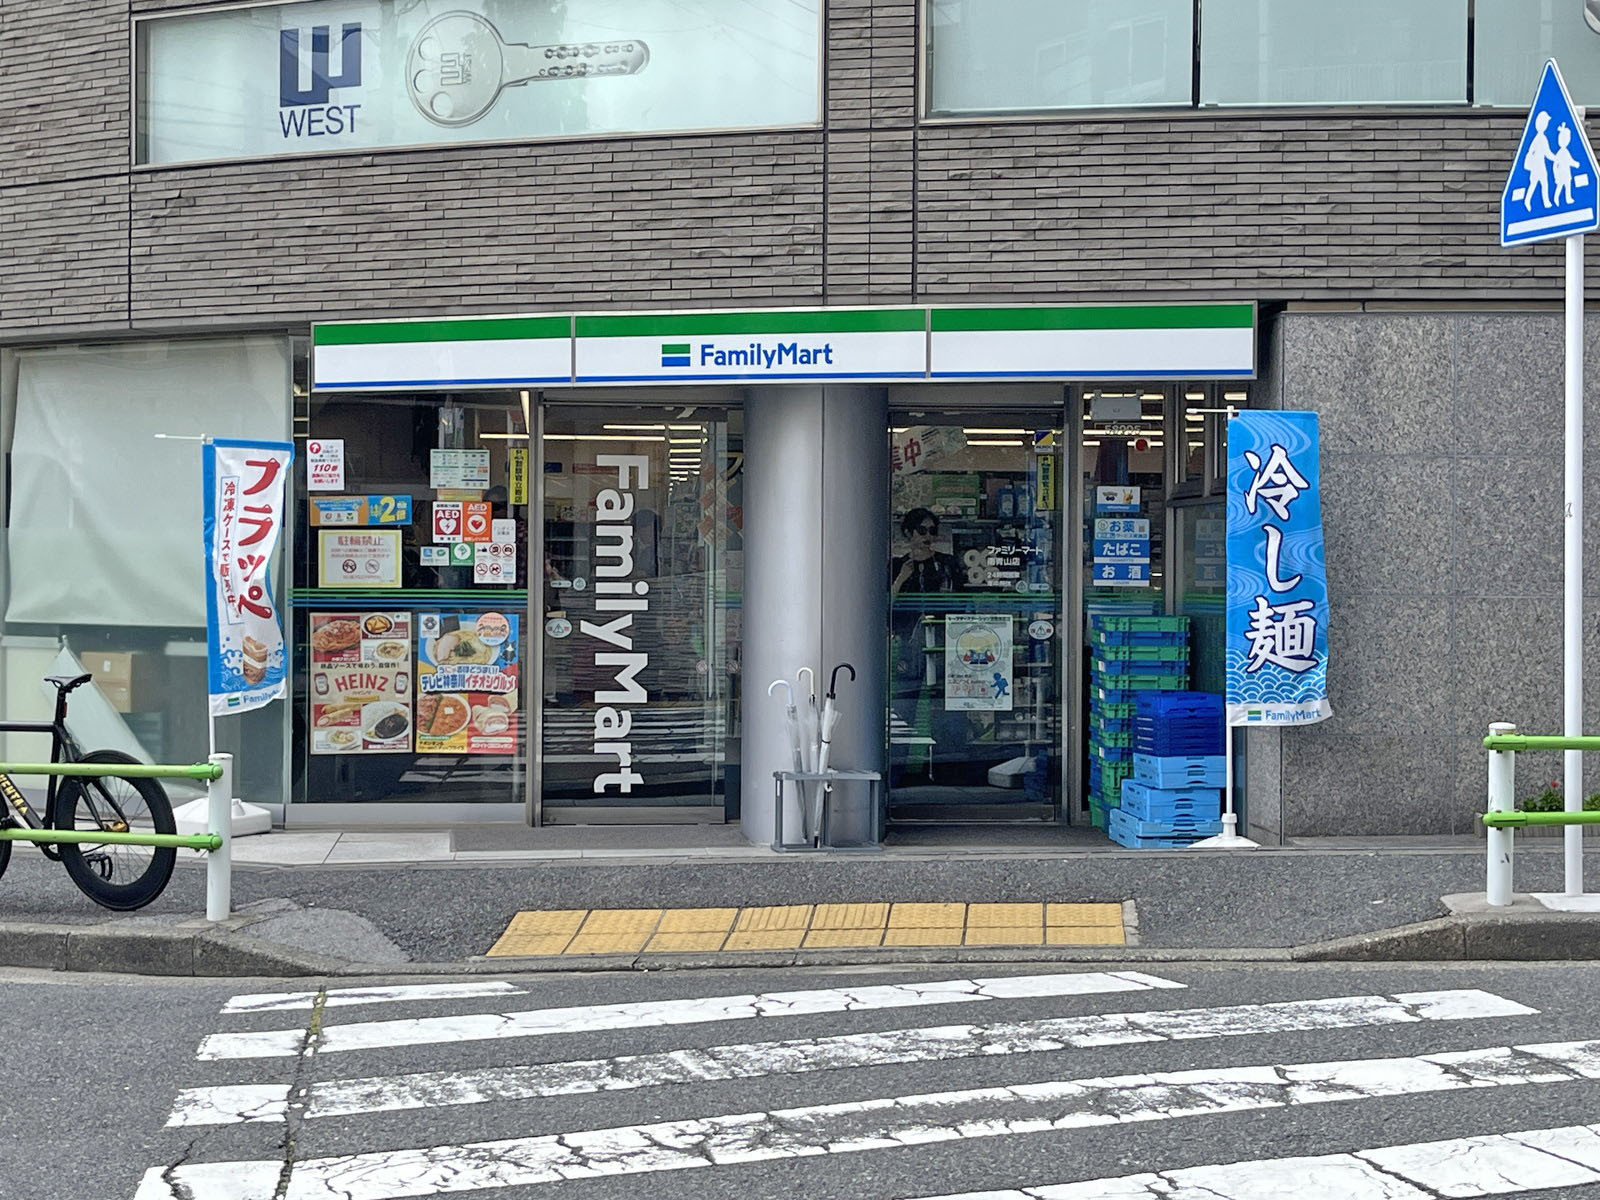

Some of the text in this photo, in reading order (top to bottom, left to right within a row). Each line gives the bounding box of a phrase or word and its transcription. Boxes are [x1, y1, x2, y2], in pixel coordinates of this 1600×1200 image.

[279, 105, 362, 138] WEST
[701, 343, 833, 369] FamilyMart
[436, 510, 460, 519] AED
[468, 503, 488, 512] AED
[237, 457, 281, 620] フラッペ
[1102, 542, 1142, 556] たばこ
[987, 545, 1043, 556] ファミリーマート
[1244, 443, 1319, 674] 冷し麺
[580, 454, 649, 794] FamilyMart
[334, 673, 389, 692] HEINZ
